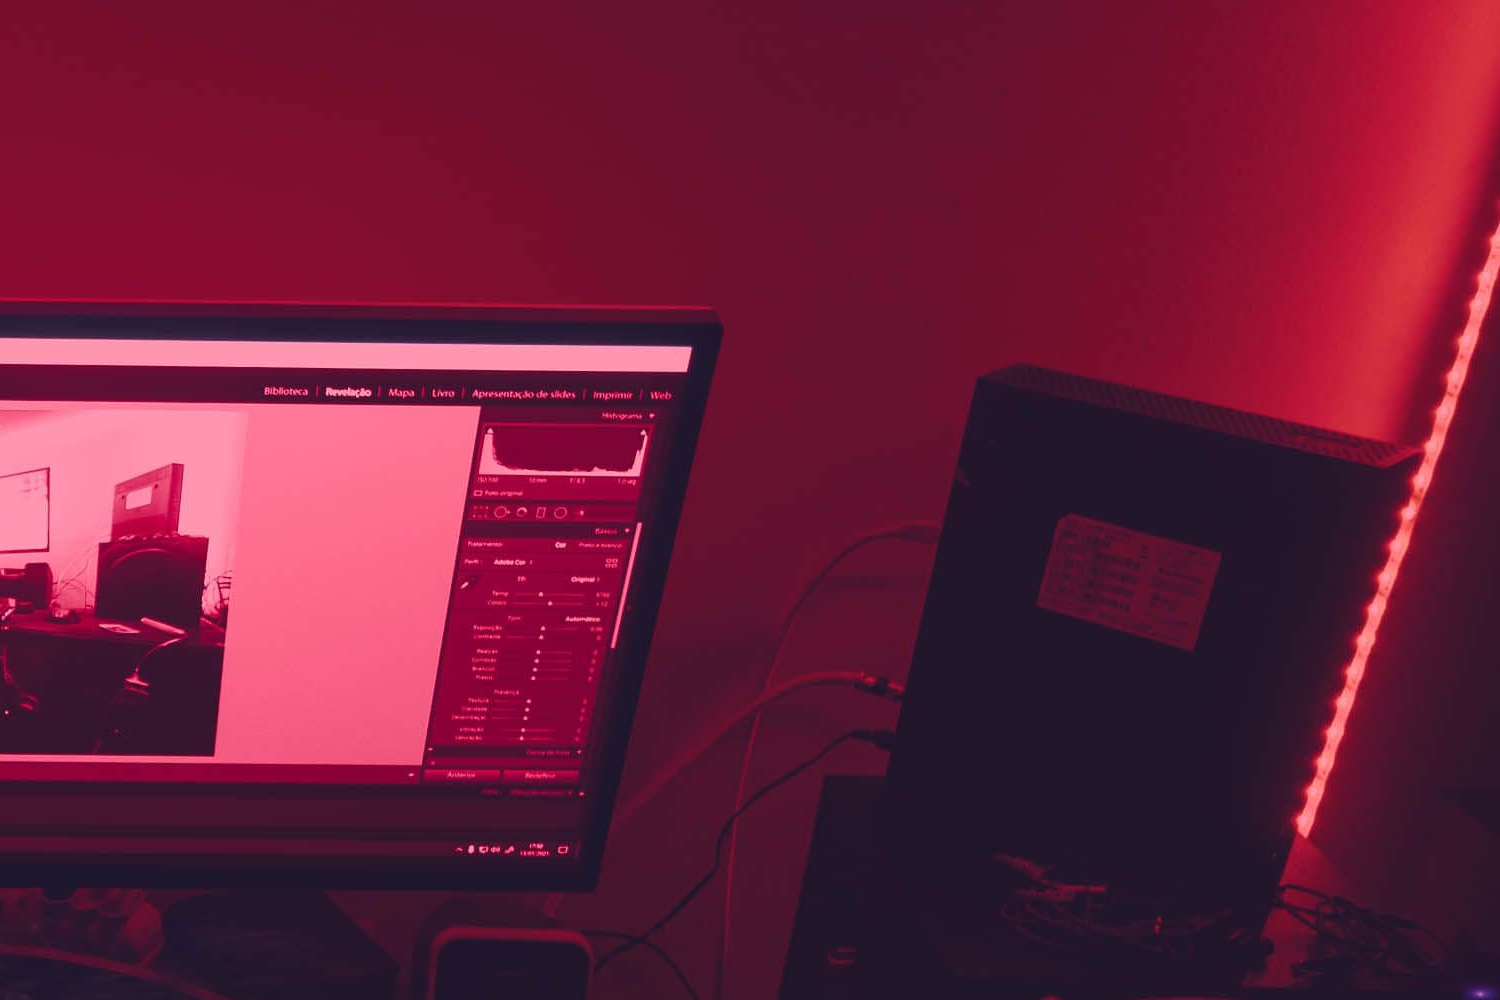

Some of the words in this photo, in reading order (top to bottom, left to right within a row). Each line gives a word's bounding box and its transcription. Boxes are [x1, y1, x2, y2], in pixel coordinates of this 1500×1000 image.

[263, 386, 309, 397] Biblioteca
[325, 387, 372, 398] Revelação
[388, 388, 415, 399] Mapa
[431, 388, 455, 398] Livro
[471, 388, 534, 400] Apresentação
[535, 389, 549, 399] de
[550, 389, 576, 399] slides
[592, 390, 633, 401] Imprimir
[650, 391, 673, 401] Web
[601, 411, 644, 420] Histograma
[555, 541, 568, 549] Cor
[493, 558, 514, 566] Adobe
